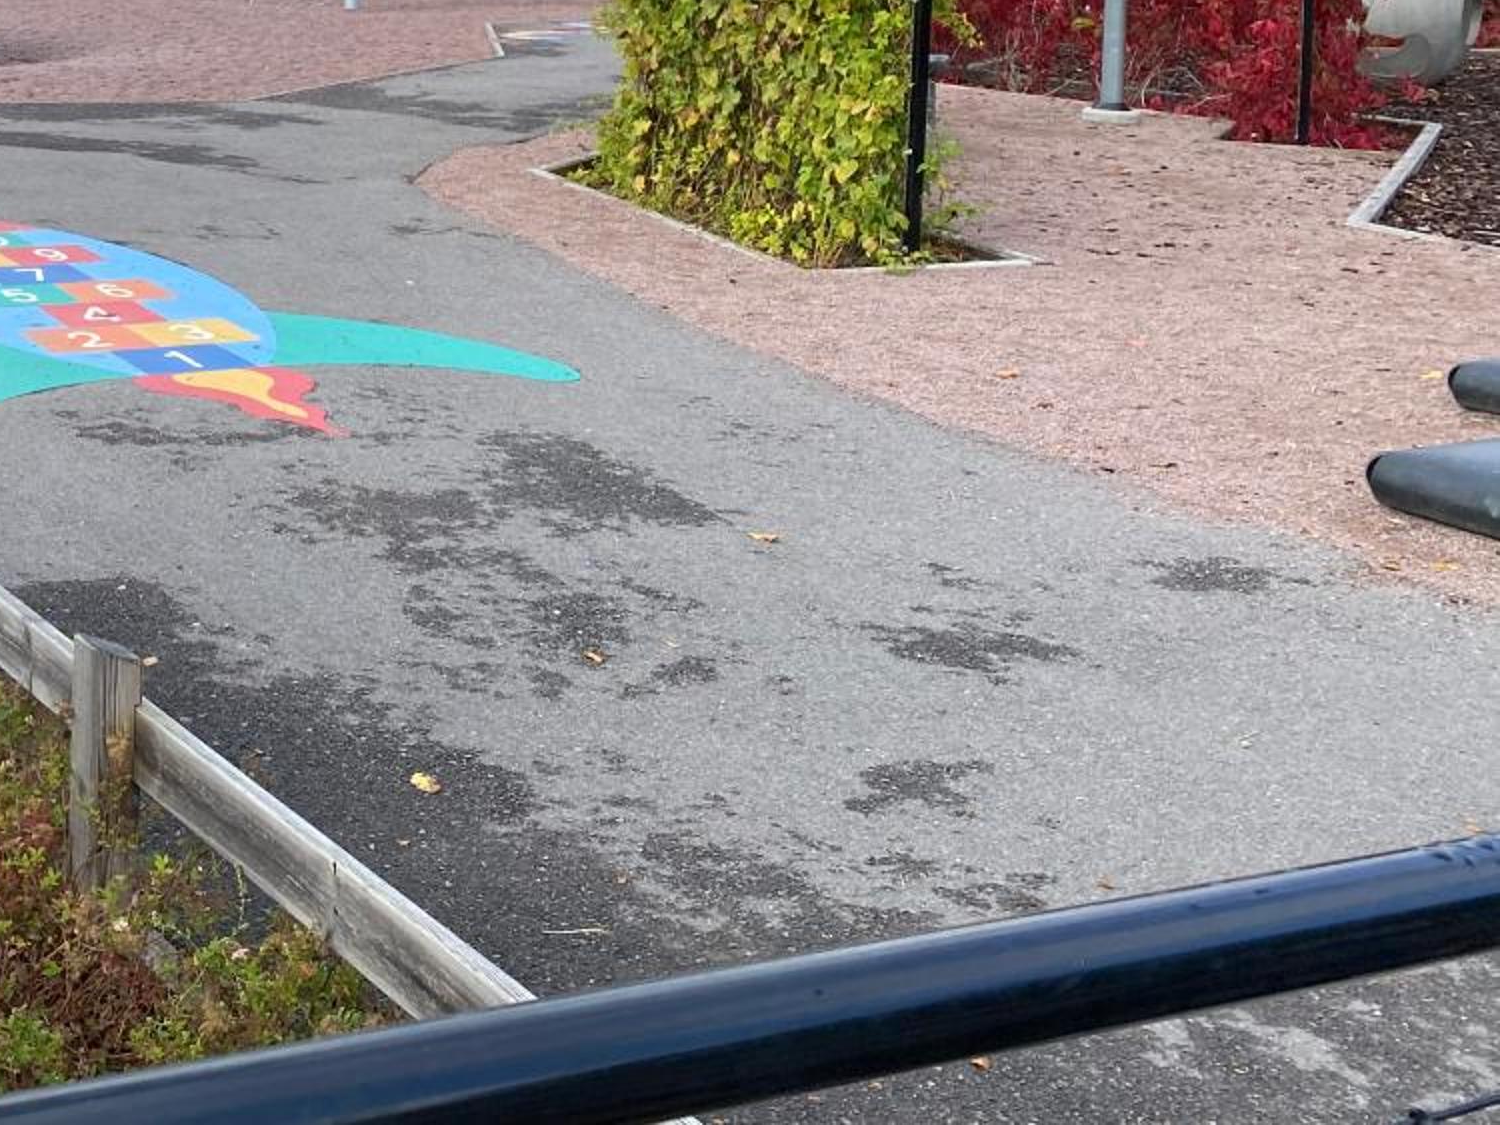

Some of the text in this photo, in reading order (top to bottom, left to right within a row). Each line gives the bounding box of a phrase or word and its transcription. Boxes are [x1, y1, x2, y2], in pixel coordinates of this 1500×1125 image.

[33, 248, 69, 262] 9
[14, 268, 45, 281] 7
[1, 288, 38, 302] 5
[95, 283, 134, 298] 6
[83, 306, 121, 322] 4
[68, 330, 116, 348] 2
[169, 324, 214, 340] 3
[164, 350, 204, 368] 1
